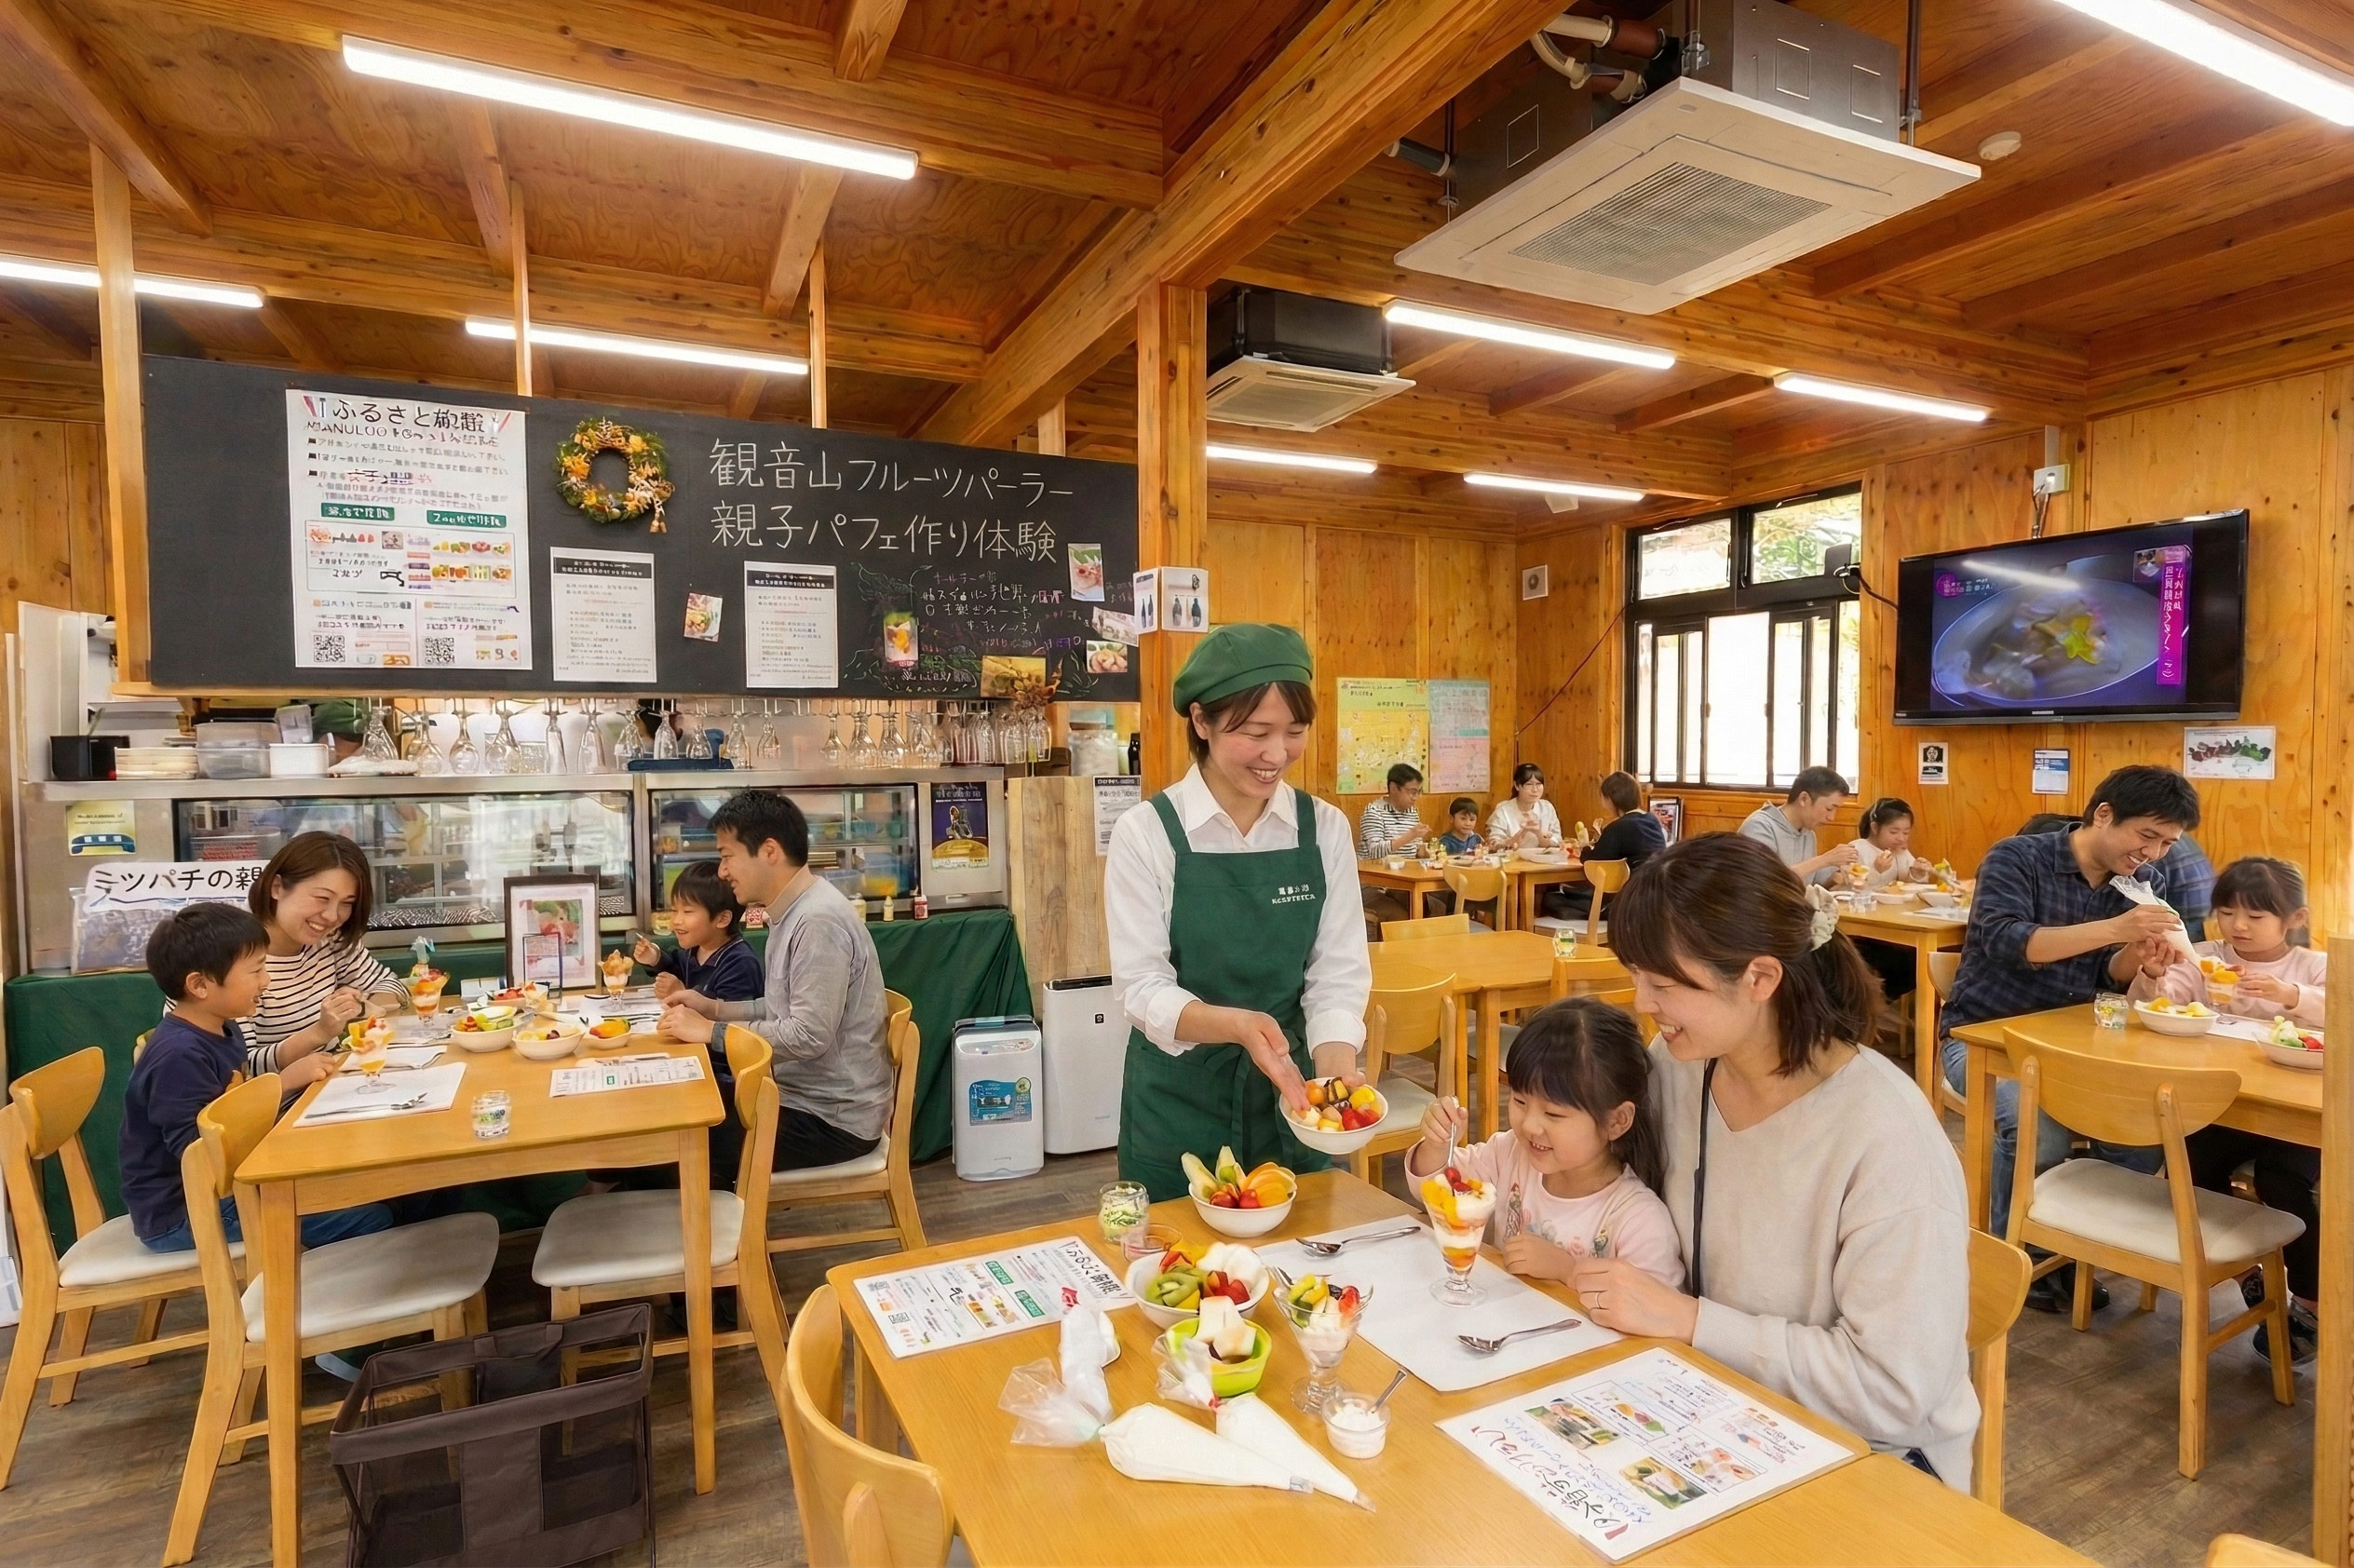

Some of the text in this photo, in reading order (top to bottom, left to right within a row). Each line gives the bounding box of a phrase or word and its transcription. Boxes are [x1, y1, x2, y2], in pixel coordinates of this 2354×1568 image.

[709, 438, 1074, 508] 観音山フルーツパーラー
[710, 499, 1058, 563] 親子パフェ作り体験
